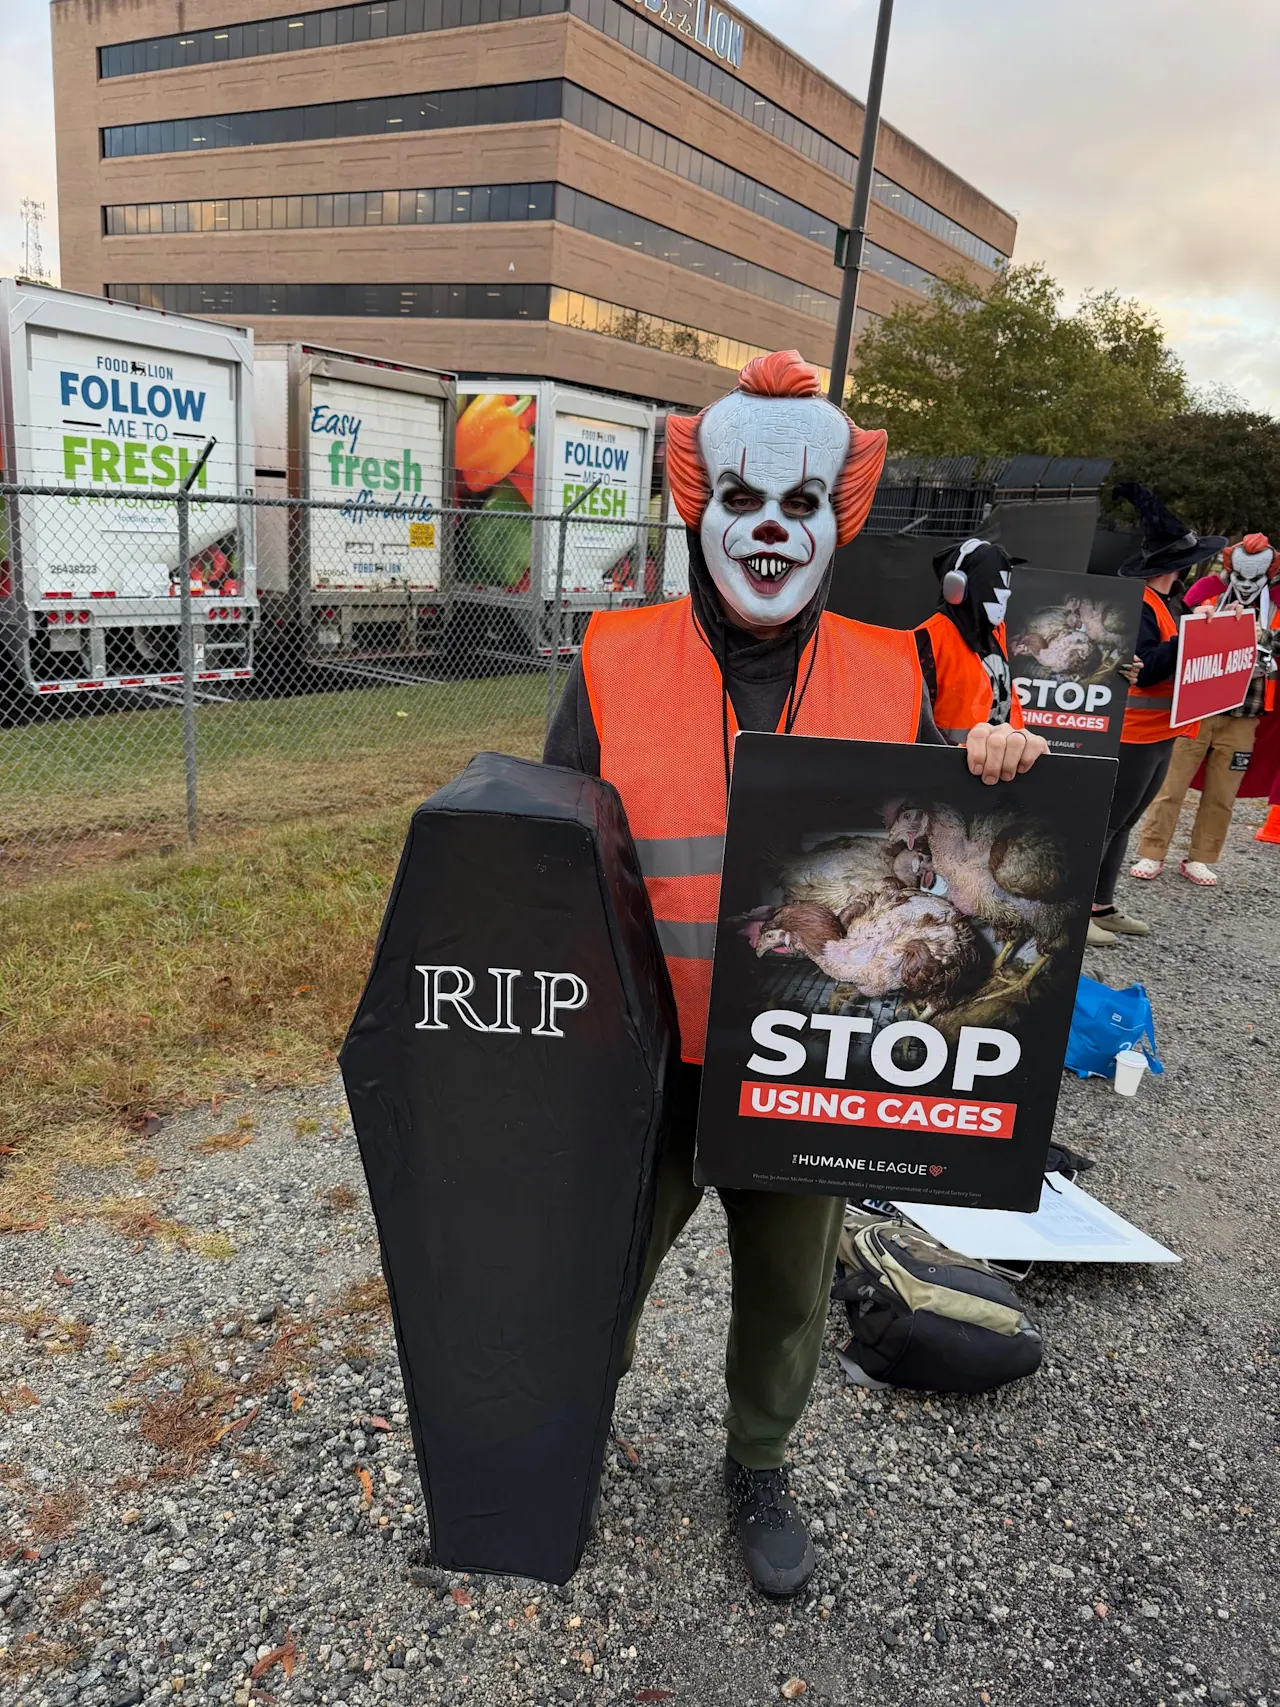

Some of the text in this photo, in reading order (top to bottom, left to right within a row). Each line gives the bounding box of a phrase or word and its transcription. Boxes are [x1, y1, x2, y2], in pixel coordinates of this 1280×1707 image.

[695, 0, 744, 69] LION
[96, 356, 173, 380] FOOD LION
[60, 371, 206, 422] FOLLOW
[108, 418, 169, 441] ME TO
[311, 405, 362, 454] Easy
[63, 435, 207, 489] FRESH
[328, 440, 422, 493] fresh
[565, 440, 629, 472] FOLLOW
[562, 483, 627, 518] FRESH
[1181, 646, 1255, 685] ANIMAL ABUSE
[1012, 676, 1112, 712] STOP
[1021, 710, 1105, 729] SING CAGES
[415, 965, 589, 1038] RIP
[746, 1009, 1021, 1091] STOP
[751, 1087, 1002, 1132] USING CAGES
[798, 1154, 866, 1170] HUMANE
[868, 1160, 928, 1176] LEAGUE
